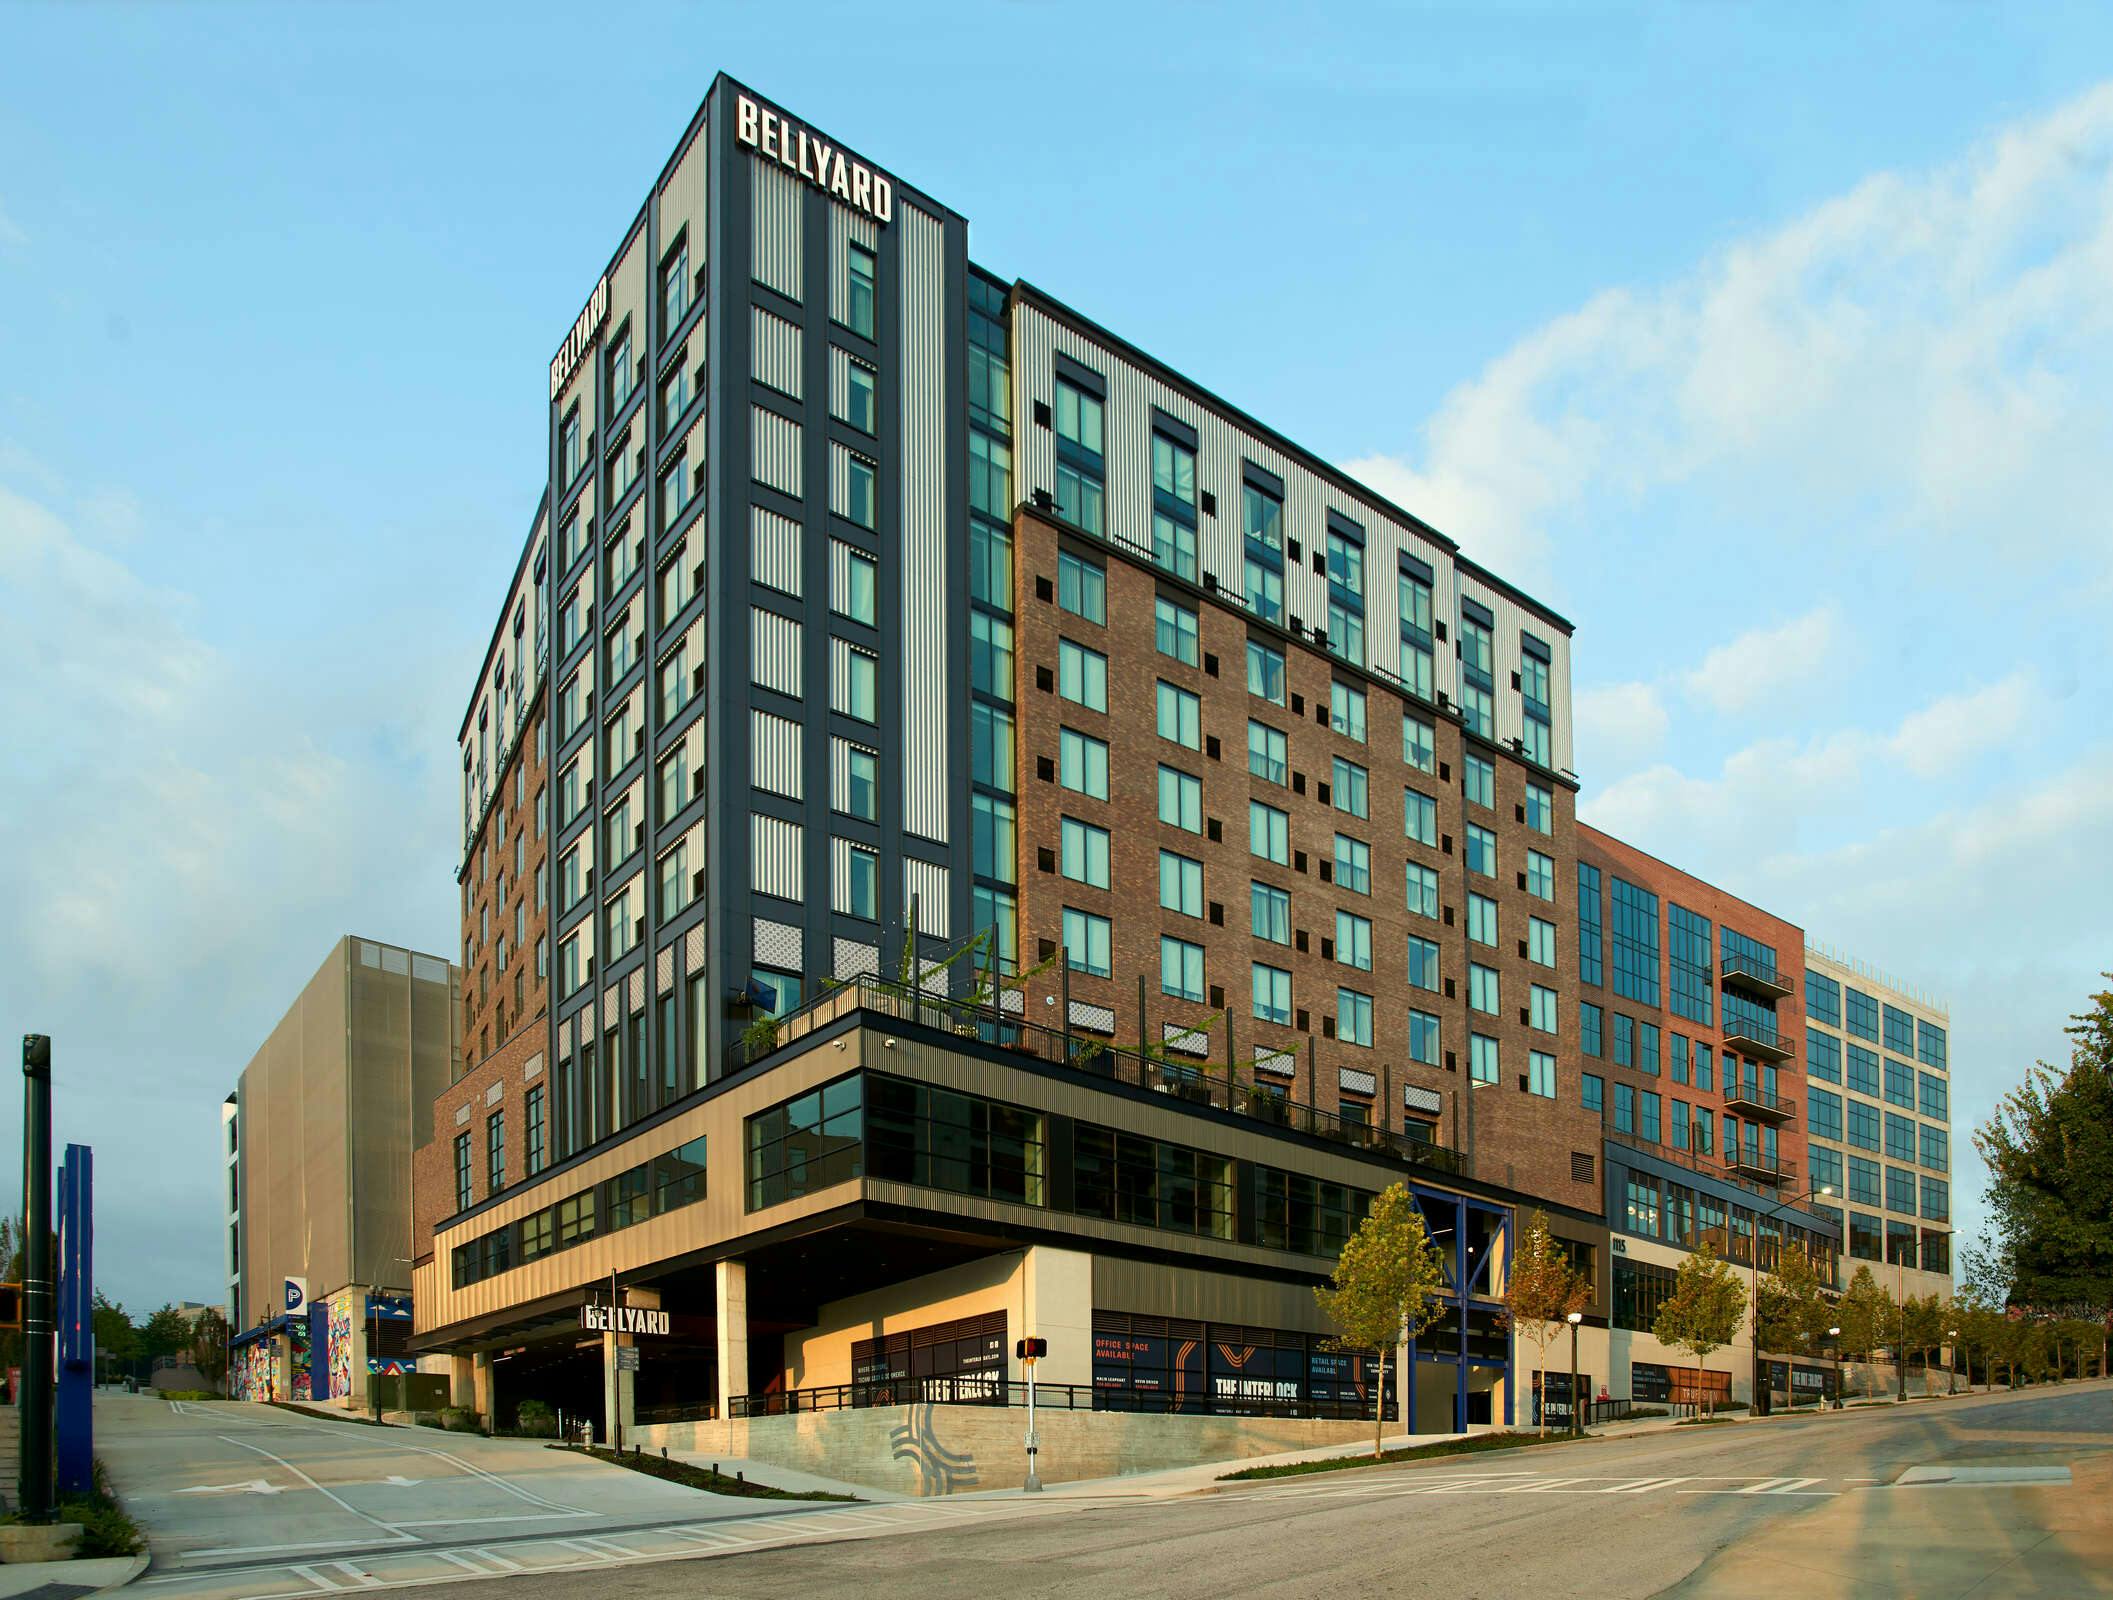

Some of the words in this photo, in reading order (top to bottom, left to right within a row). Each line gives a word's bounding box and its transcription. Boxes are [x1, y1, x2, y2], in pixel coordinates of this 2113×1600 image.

[736, 93, 893, 225] BELLYARD
[550, 274, 609, 402] BELLYARD
[585, 1304, 670, 1335] BELLYARD
[1095, 1339, 1122, 1350] OFFICE
[1096, 1349, 1136, 1360] AVAILABLE
[1216, 1378, 1237, 1399] THE
[1239, 1380, 1298, 1402] INTERLOCK
